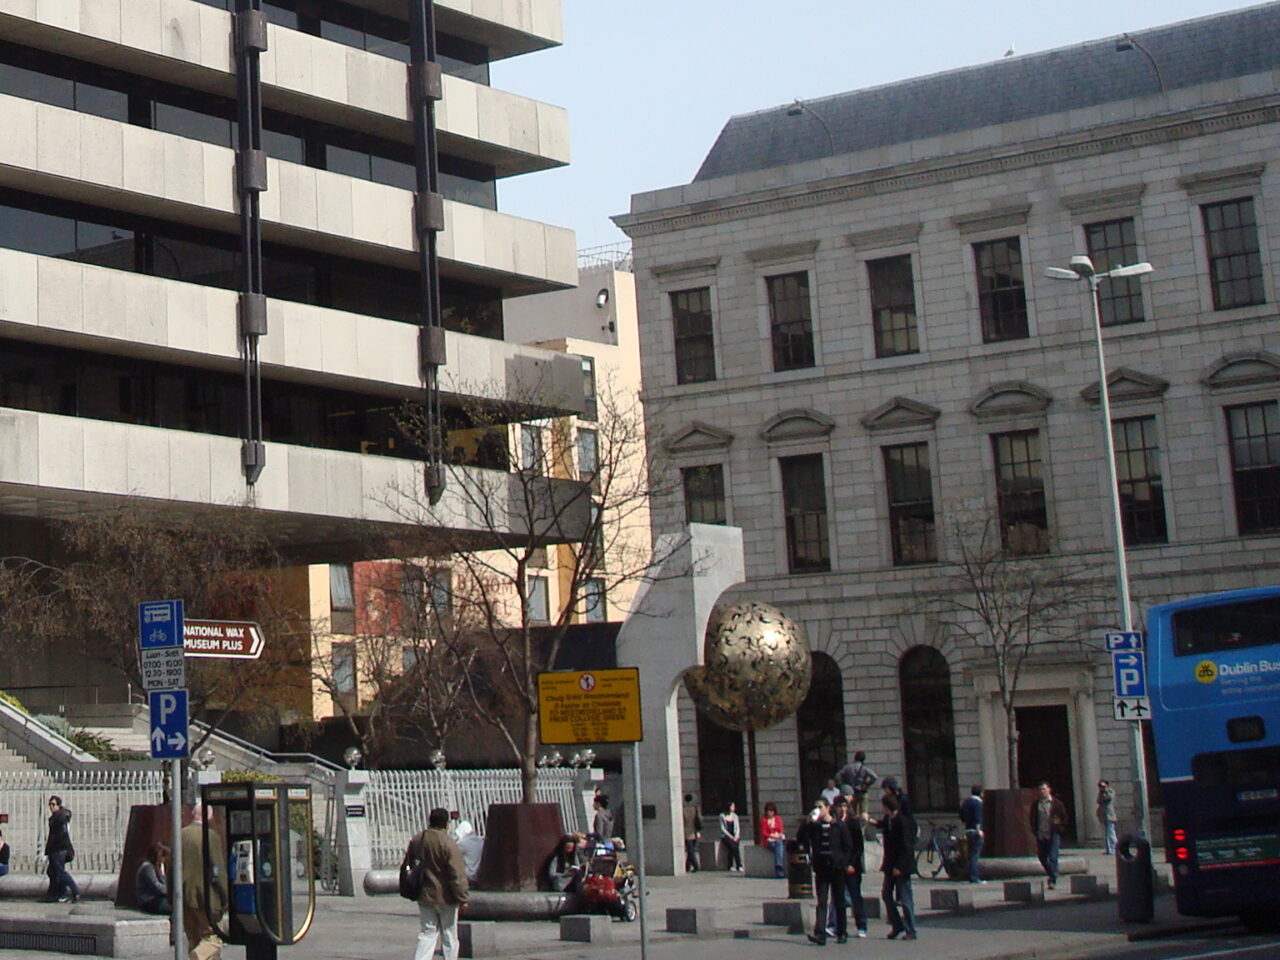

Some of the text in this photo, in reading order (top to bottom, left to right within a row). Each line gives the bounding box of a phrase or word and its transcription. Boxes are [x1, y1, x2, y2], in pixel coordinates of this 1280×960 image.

[183, 625, 245, 638] NATIONAL WAX
[183, 638, 243, 651] MUSEUM PLUS
[1108, 634, 1124, 648] P
[146, 651, 161, 659] Luan
[1219, 659, 1280, 676] Dublin Bus
[147, 679, 163, 687] MON
[167, 678, 180, 686] SAT
[1120, 668, 1140, 695] P
[160, 694, 177, 725] P
